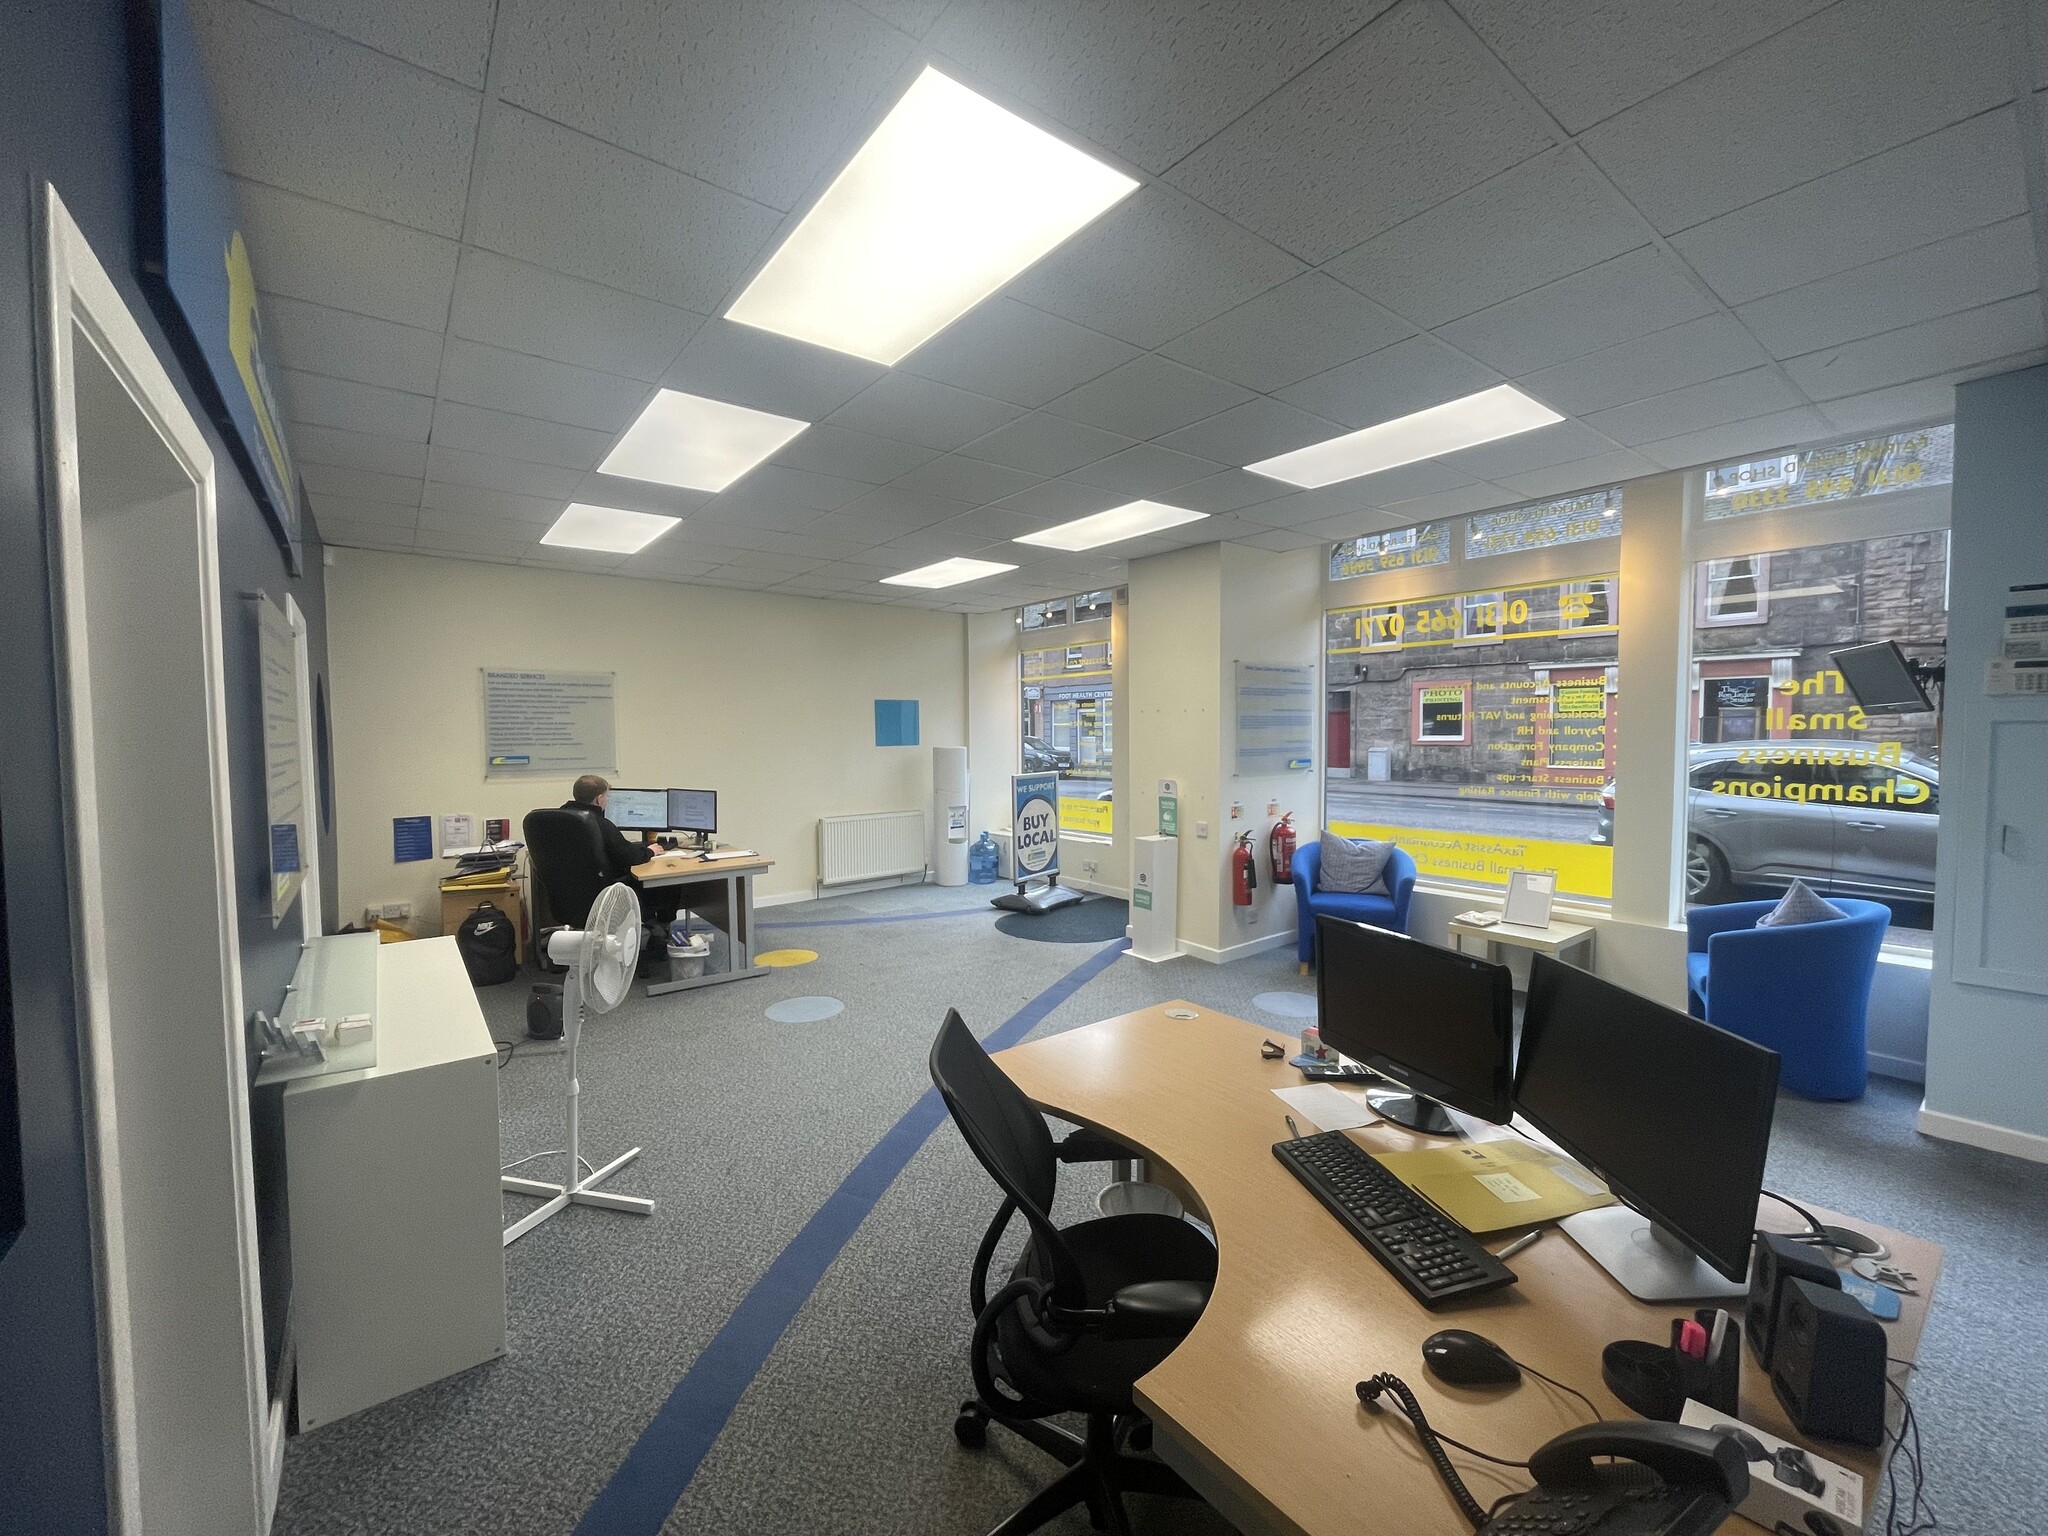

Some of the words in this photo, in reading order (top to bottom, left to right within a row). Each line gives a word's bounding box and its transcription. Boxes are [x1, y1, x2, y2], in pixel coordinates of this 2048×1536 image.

[1423, 689, 1463, 697] PHOTO
[1016, 785, 1027, 793] WE
[1028, 782, 1055, 792] SUPPORT
[1023, 813, 1049, 831] BUY
[1017, 829, 1057, 850] LOCAL
